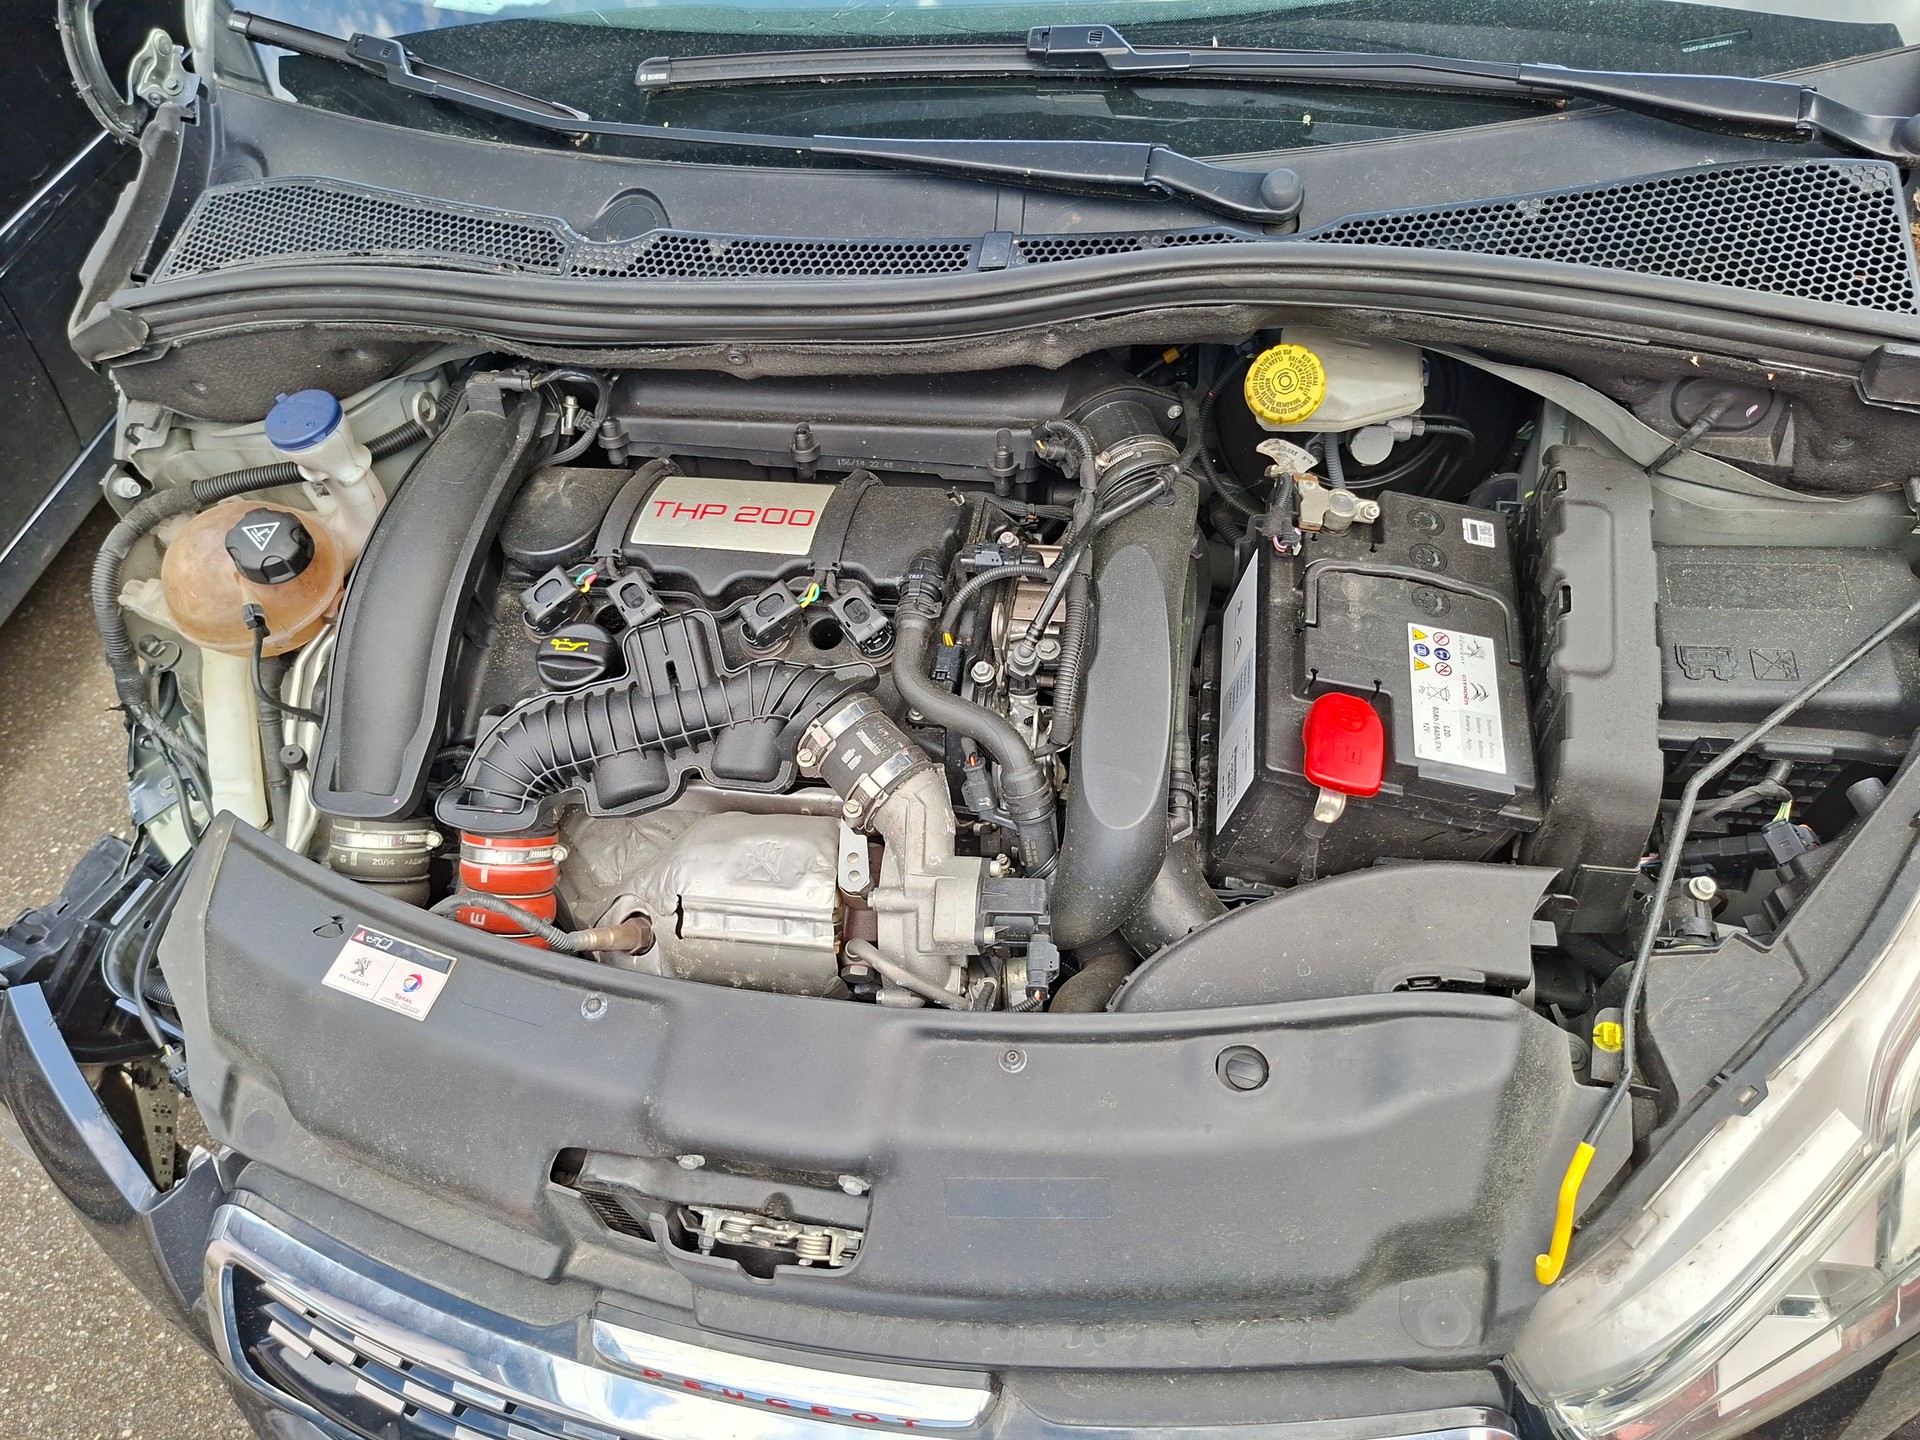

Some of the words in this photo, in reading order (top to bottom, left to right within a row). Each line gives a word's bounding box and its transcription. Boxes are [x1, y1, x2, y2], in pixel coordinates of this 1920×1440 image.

[653, 500, 728, 520] THP
[733, 506, 816, 527] 200
[338, 973, 371, 988] PEUGEOT
[394, 992, 413, 1005] TOTAL
[641, 1367, 921, 1429] PEUGEOT
